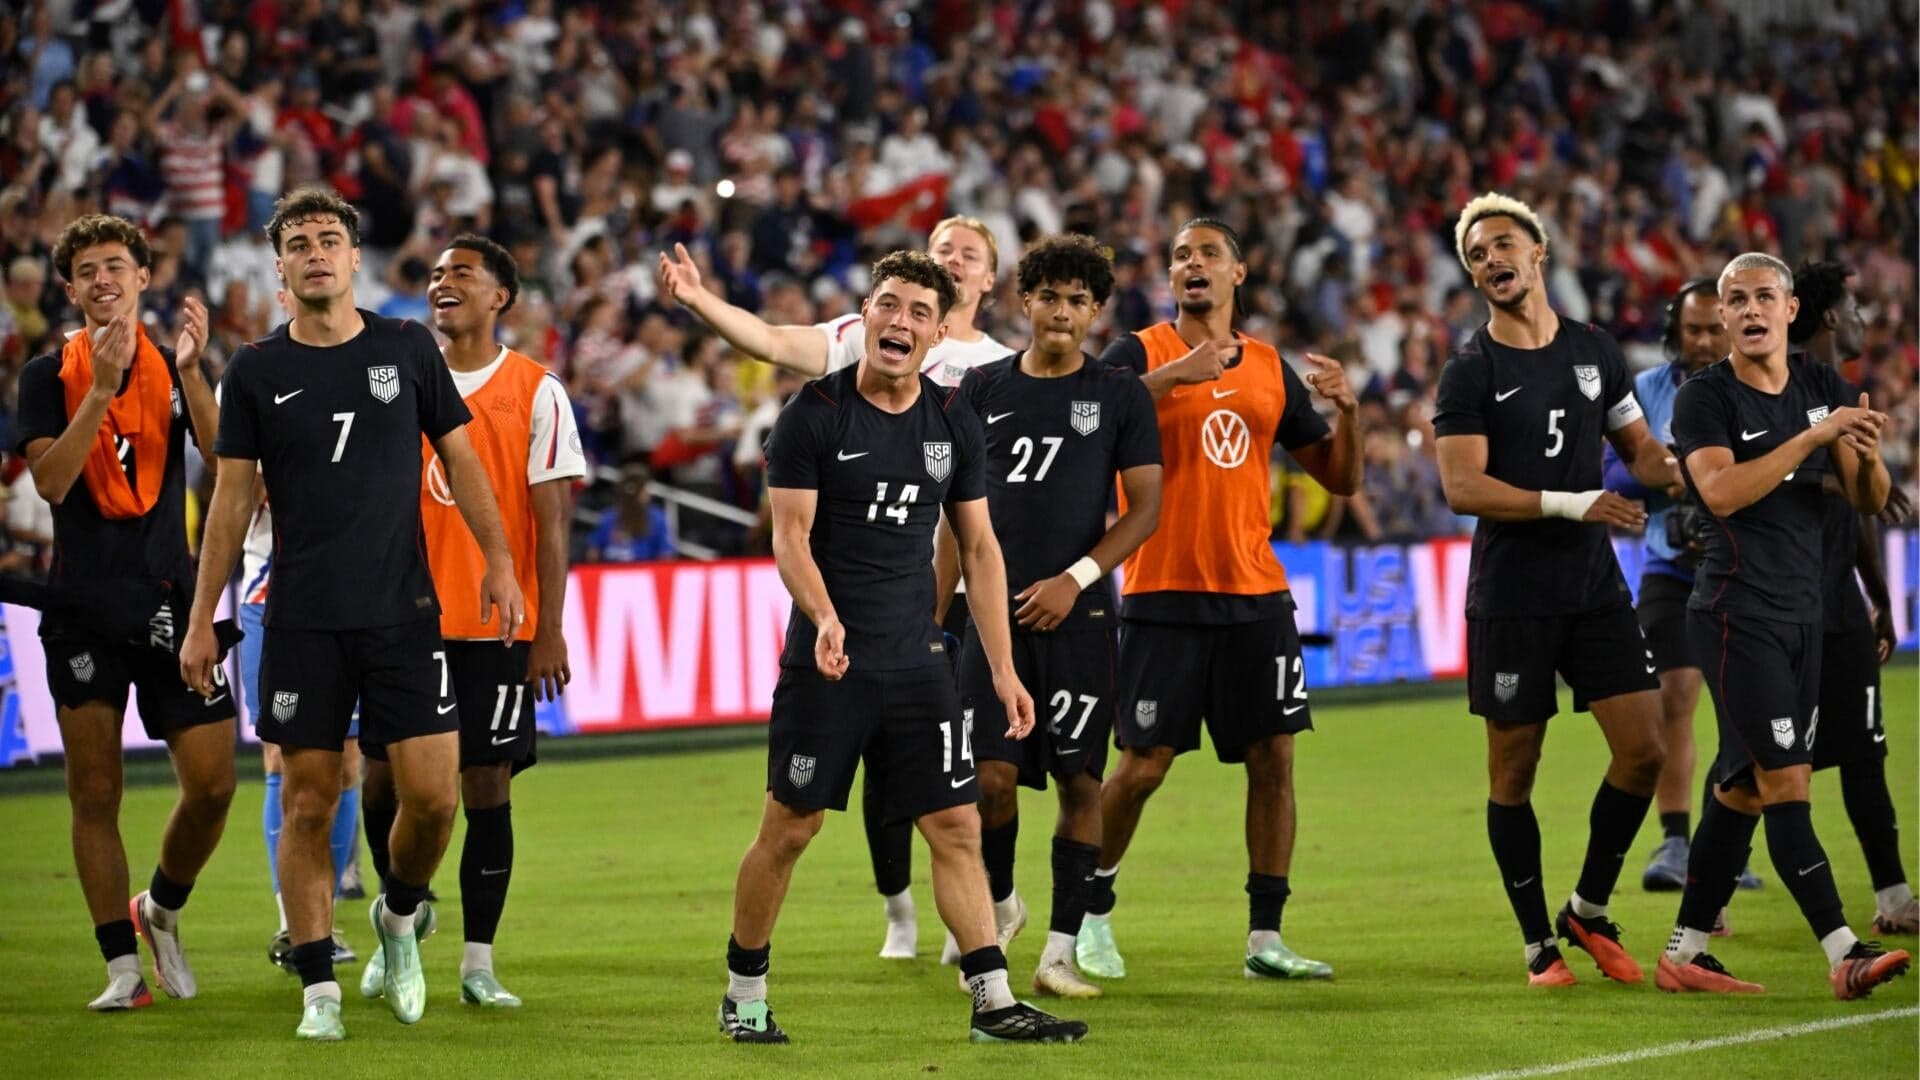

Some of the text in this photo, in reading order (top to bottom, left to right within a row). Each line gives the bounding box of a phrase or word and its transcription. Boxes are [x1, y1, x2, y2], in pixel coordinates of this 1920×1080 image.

[370, 368, 396, 382] USA
[1576, 367, 1598, 381] USA
[1074, 403, 1098, 416] USA
[331, 411, 355, 463] 7
[926, 444, 950, 460] USA
[1544, 408, 1565, 458] 5
[1006, 436, 1064, 483] 27
[866, 481, 921, 526] 14
[71, 653, 91, 669] USA
[432, 651, 448, 698] 7
[1275, 656, 1308, 700] 12
[276, 692, 297, 706] USA
[490, 684, 525, 731] 11
[1048, 688, 1099, 740] 27
[939, 719, 975, 773] 14
[1774, 719, 1792, 732] USA
[793, 756, 814, 771] USA
